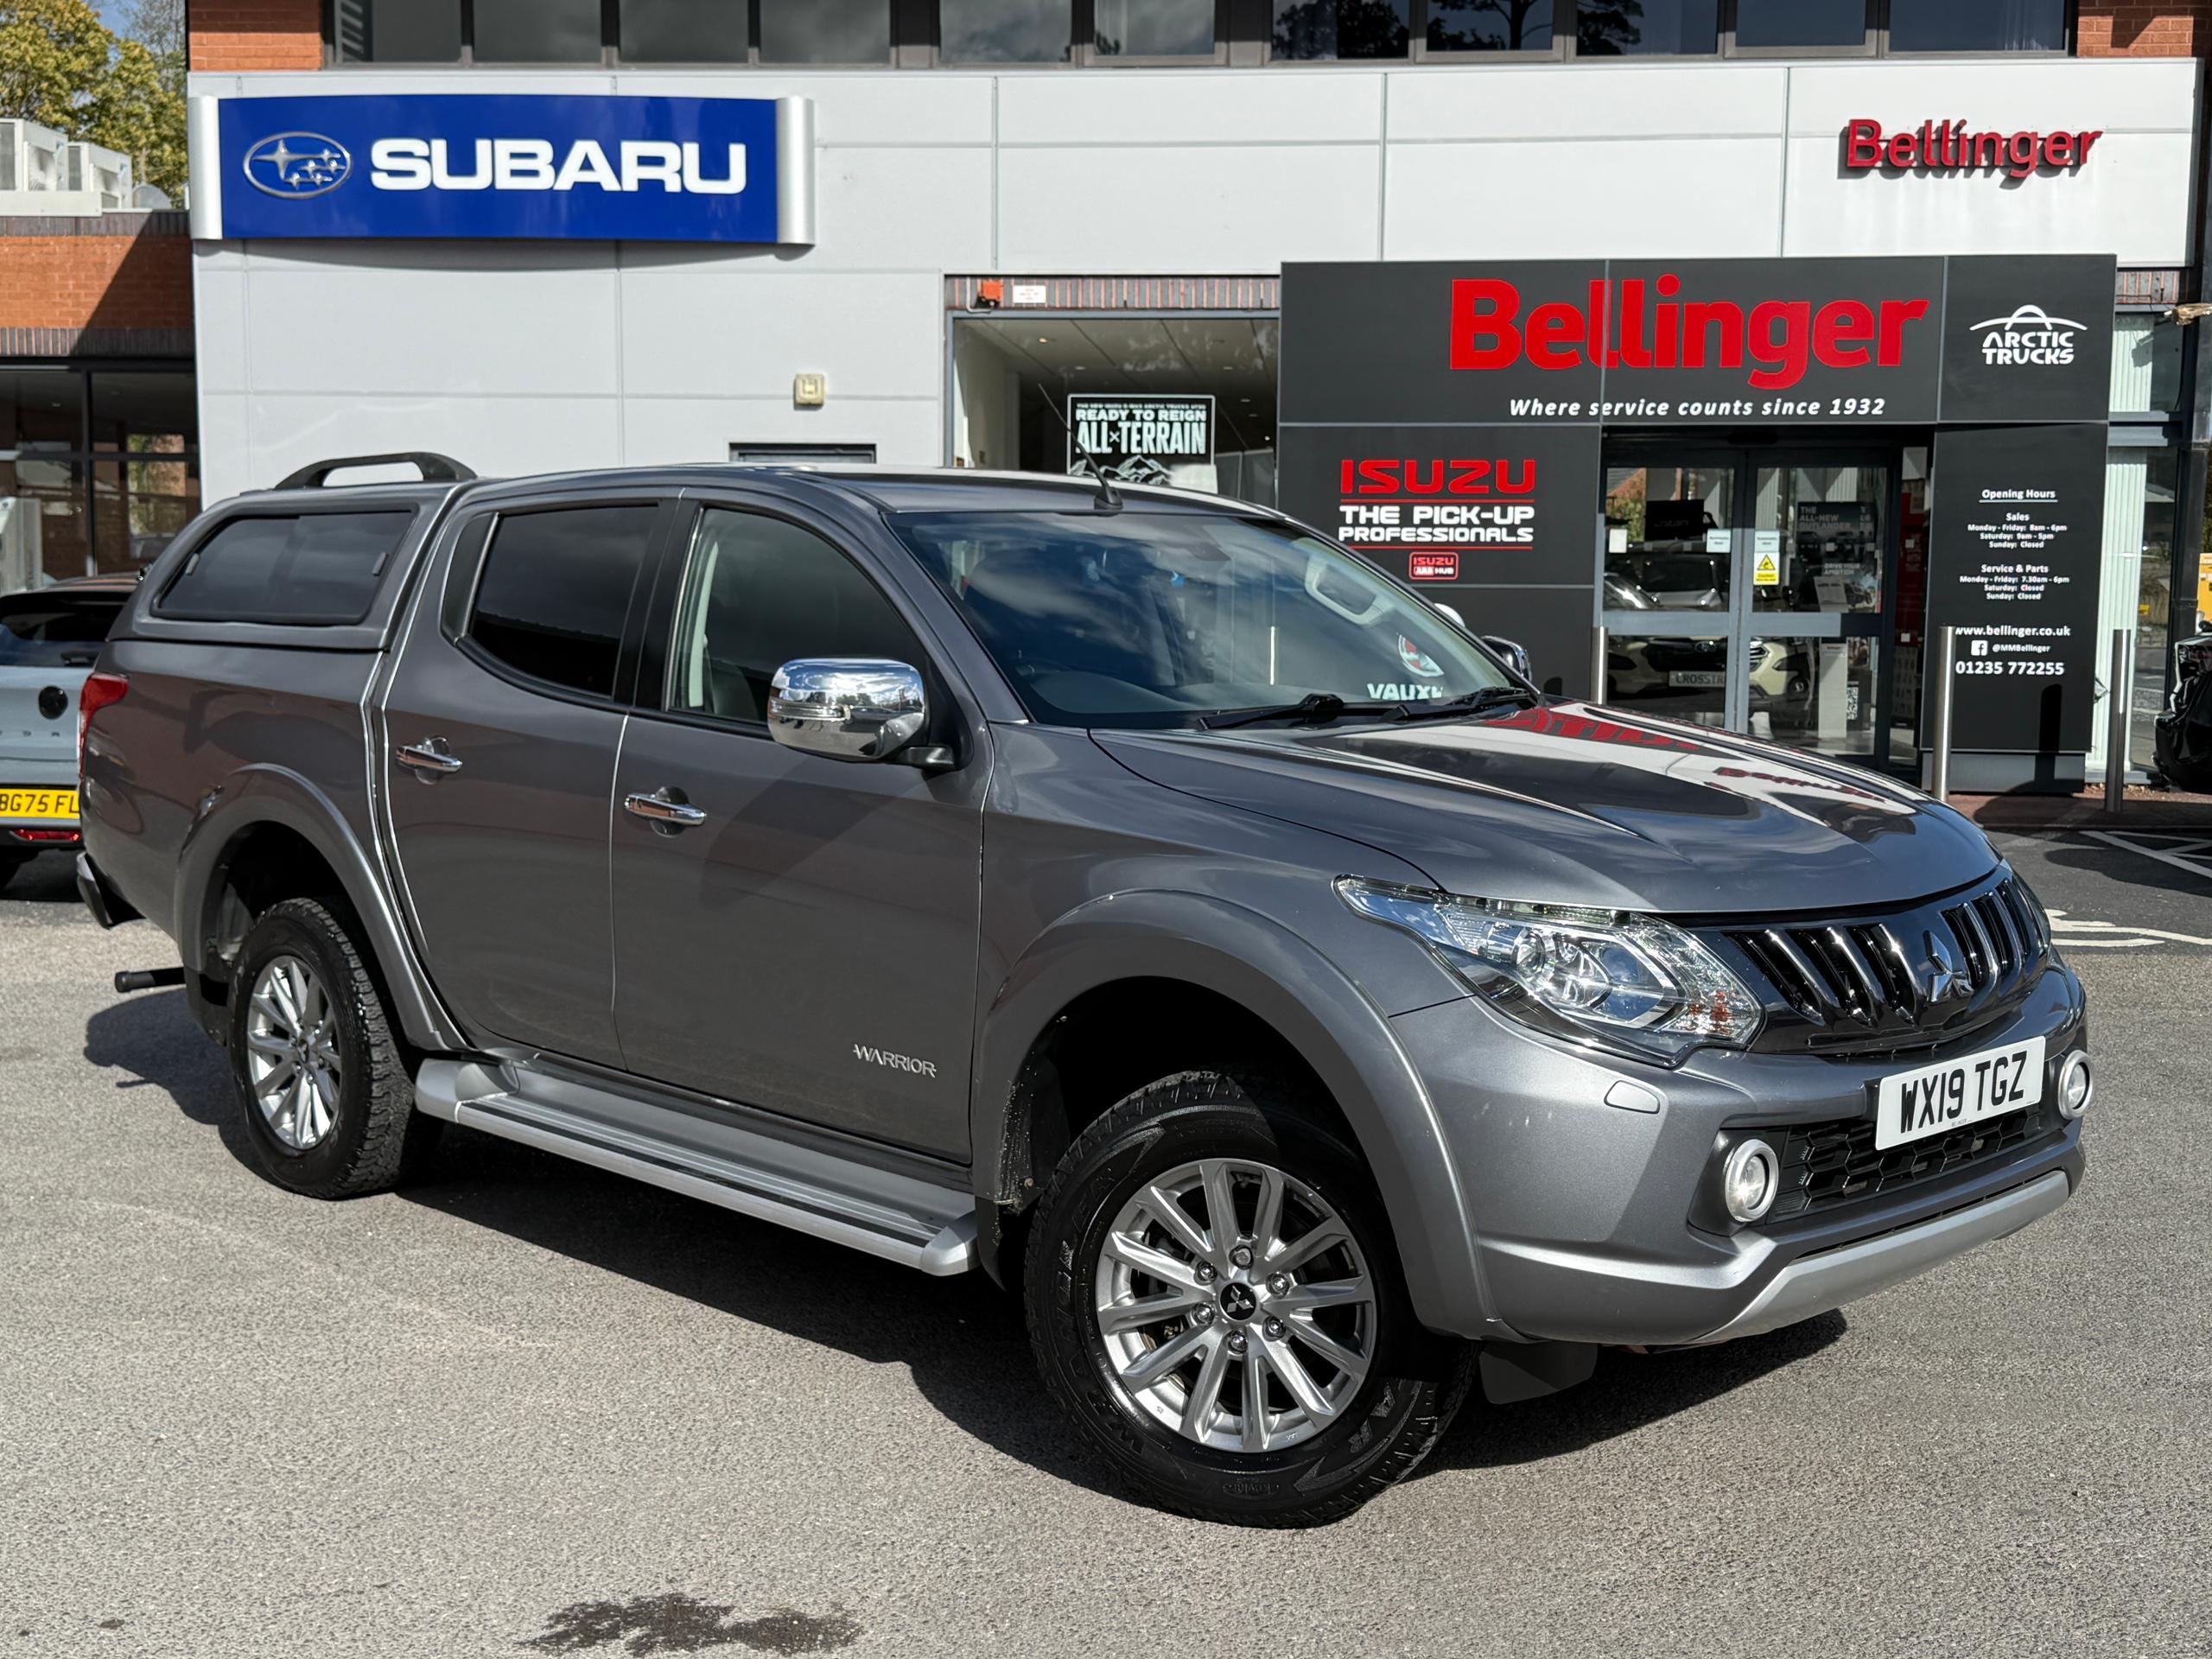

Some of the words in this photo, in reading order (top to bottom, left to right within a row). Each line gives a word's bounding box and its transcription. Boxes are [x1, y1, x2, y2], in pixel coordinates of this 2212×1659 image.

[1846, 118, 2103, 178] Bellinger
[369, 137, 747, 194] SUBARU
[1449, 273, 1929, 390] Bellinger
[1981, 330, 2074, 348] ARCTIC
[1981, 347, 2075, 365] TRUCKS
[1509, 397, 1580, 416] Where
[1588, 397, 1669, 416] service
[1677, 398, 1753, 416] counts
[1761, 397, 1821, 416] since
[1829, 397, 1885, 415] 1932
[1075, 409, 1129, 422] READY
[1132, 409, 1156, 422] TO
[1158, 409, 1207, 422] REIGN
[1340, 459, 1535, 494] ISUZU
[1981, 488, 2024, 500] Opening
[2025, 489, 2056, 499] Hours
[1338, 505, 1401, 524] THE
[1413, 505, 1535, 525] PICK-UP
[2005, 512, 2030, 521] Sales
[1338, 526, 1534, 542] PROFESSIONALS
[2050, 524, 2068, 532] 6pm
[1414, 556, 1454, 565] ISUZU
[1980, 564, 2014, 573] Service
[2015, 564, 2024, 573] &
[2025, 564, 2049, 573] Parts
[2053, 575, 2070, 584] 6pm
[1955, 625, 2071, 638] www.bellinger.co.uk
[1992, 644, 2051, 653] @MMBellinger
[1955, 660, 2003, 674] 01235
[2007, 661, 2065, 675] 772255
[852, 1043, 938, 1078] WARRIOR
[1899, 1068, 1966, 1135] WX19
[1974, 1050, 2028, 1111] TGZ
